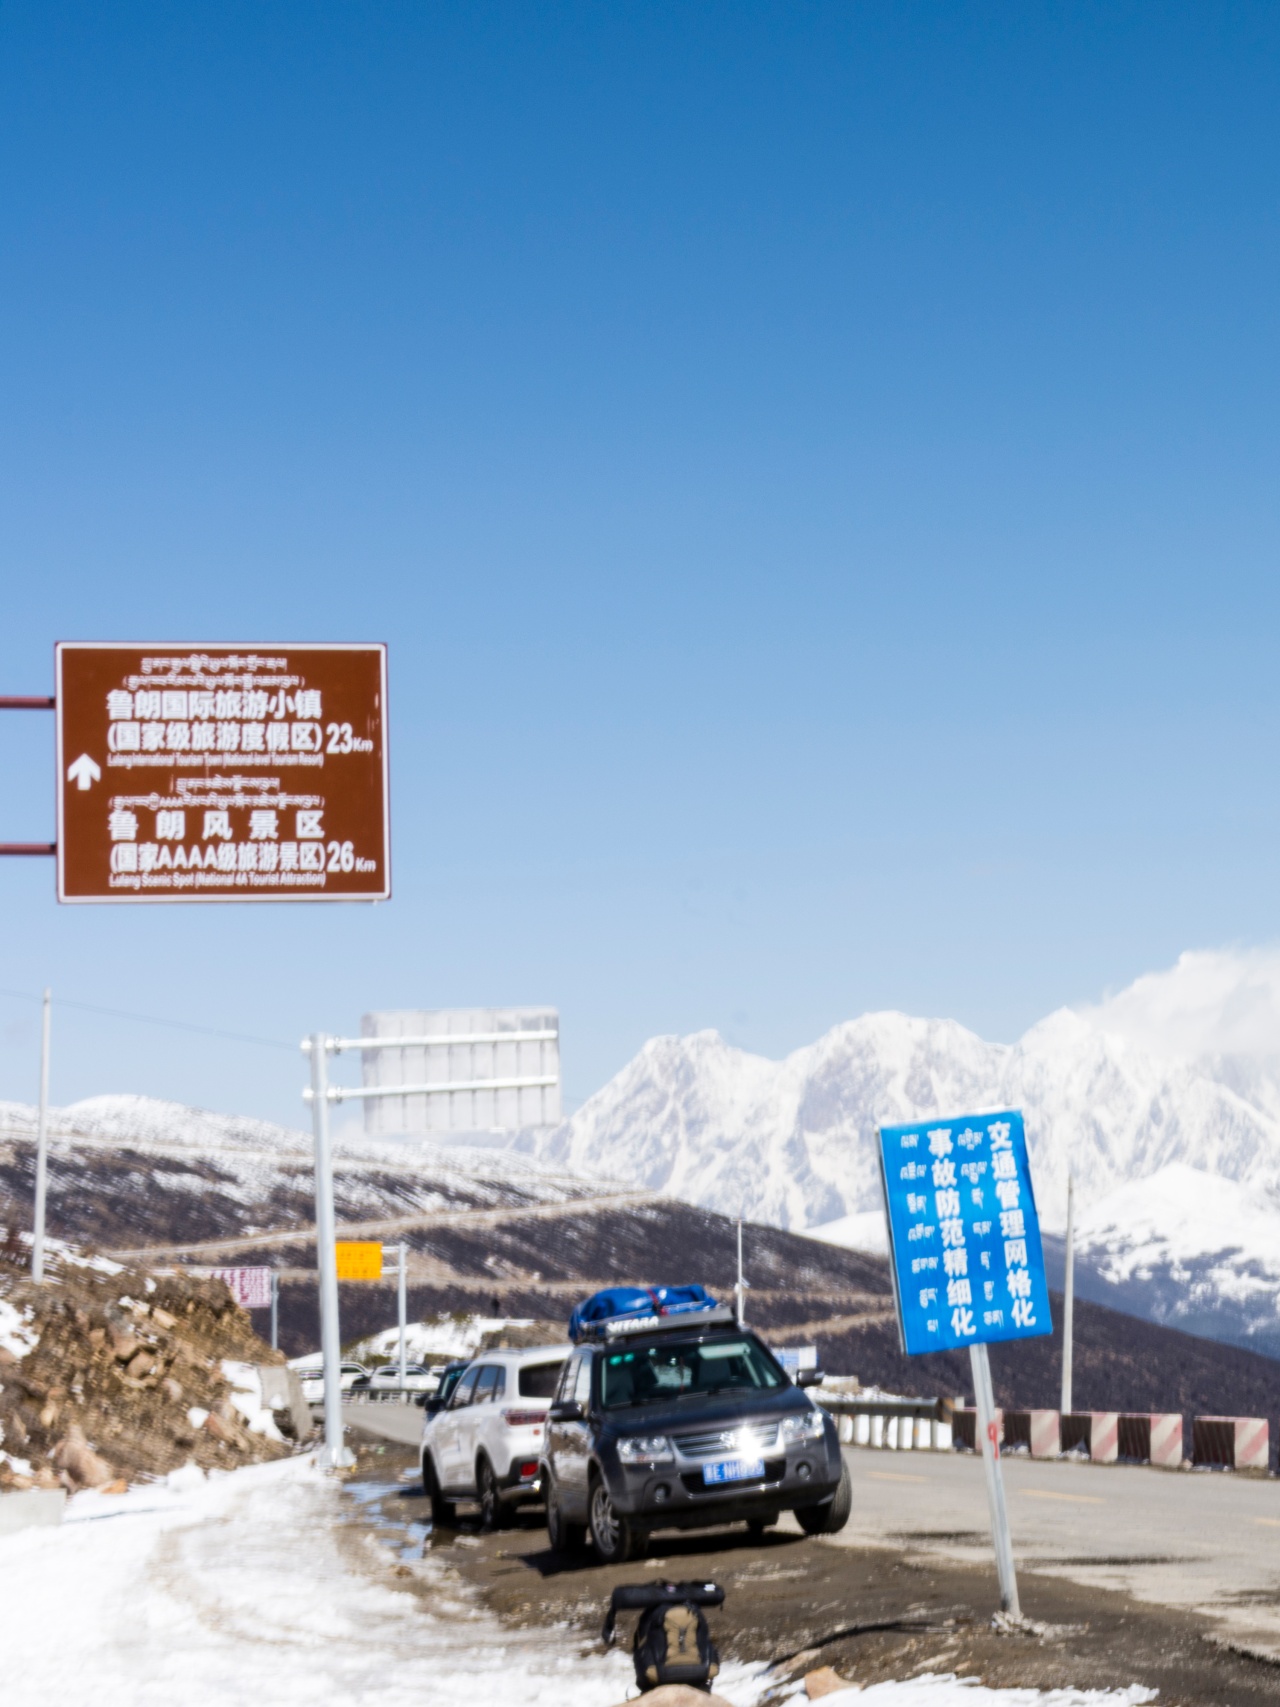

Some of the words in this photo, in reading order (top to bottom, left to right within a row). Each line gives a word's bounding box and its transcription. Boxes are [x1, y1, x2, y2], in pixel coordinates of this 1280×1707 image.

[107, 690, 322, 720] 鲁朗国际旅游小镇
[108, 810, 325, 840] 鲁朗风景区
[927, 1128, 976, 1337] 事故防范精细化
[987, 1121, 1036, 1328] 交通管理网格化
[607, 1316, 659, 1332] VITARA
